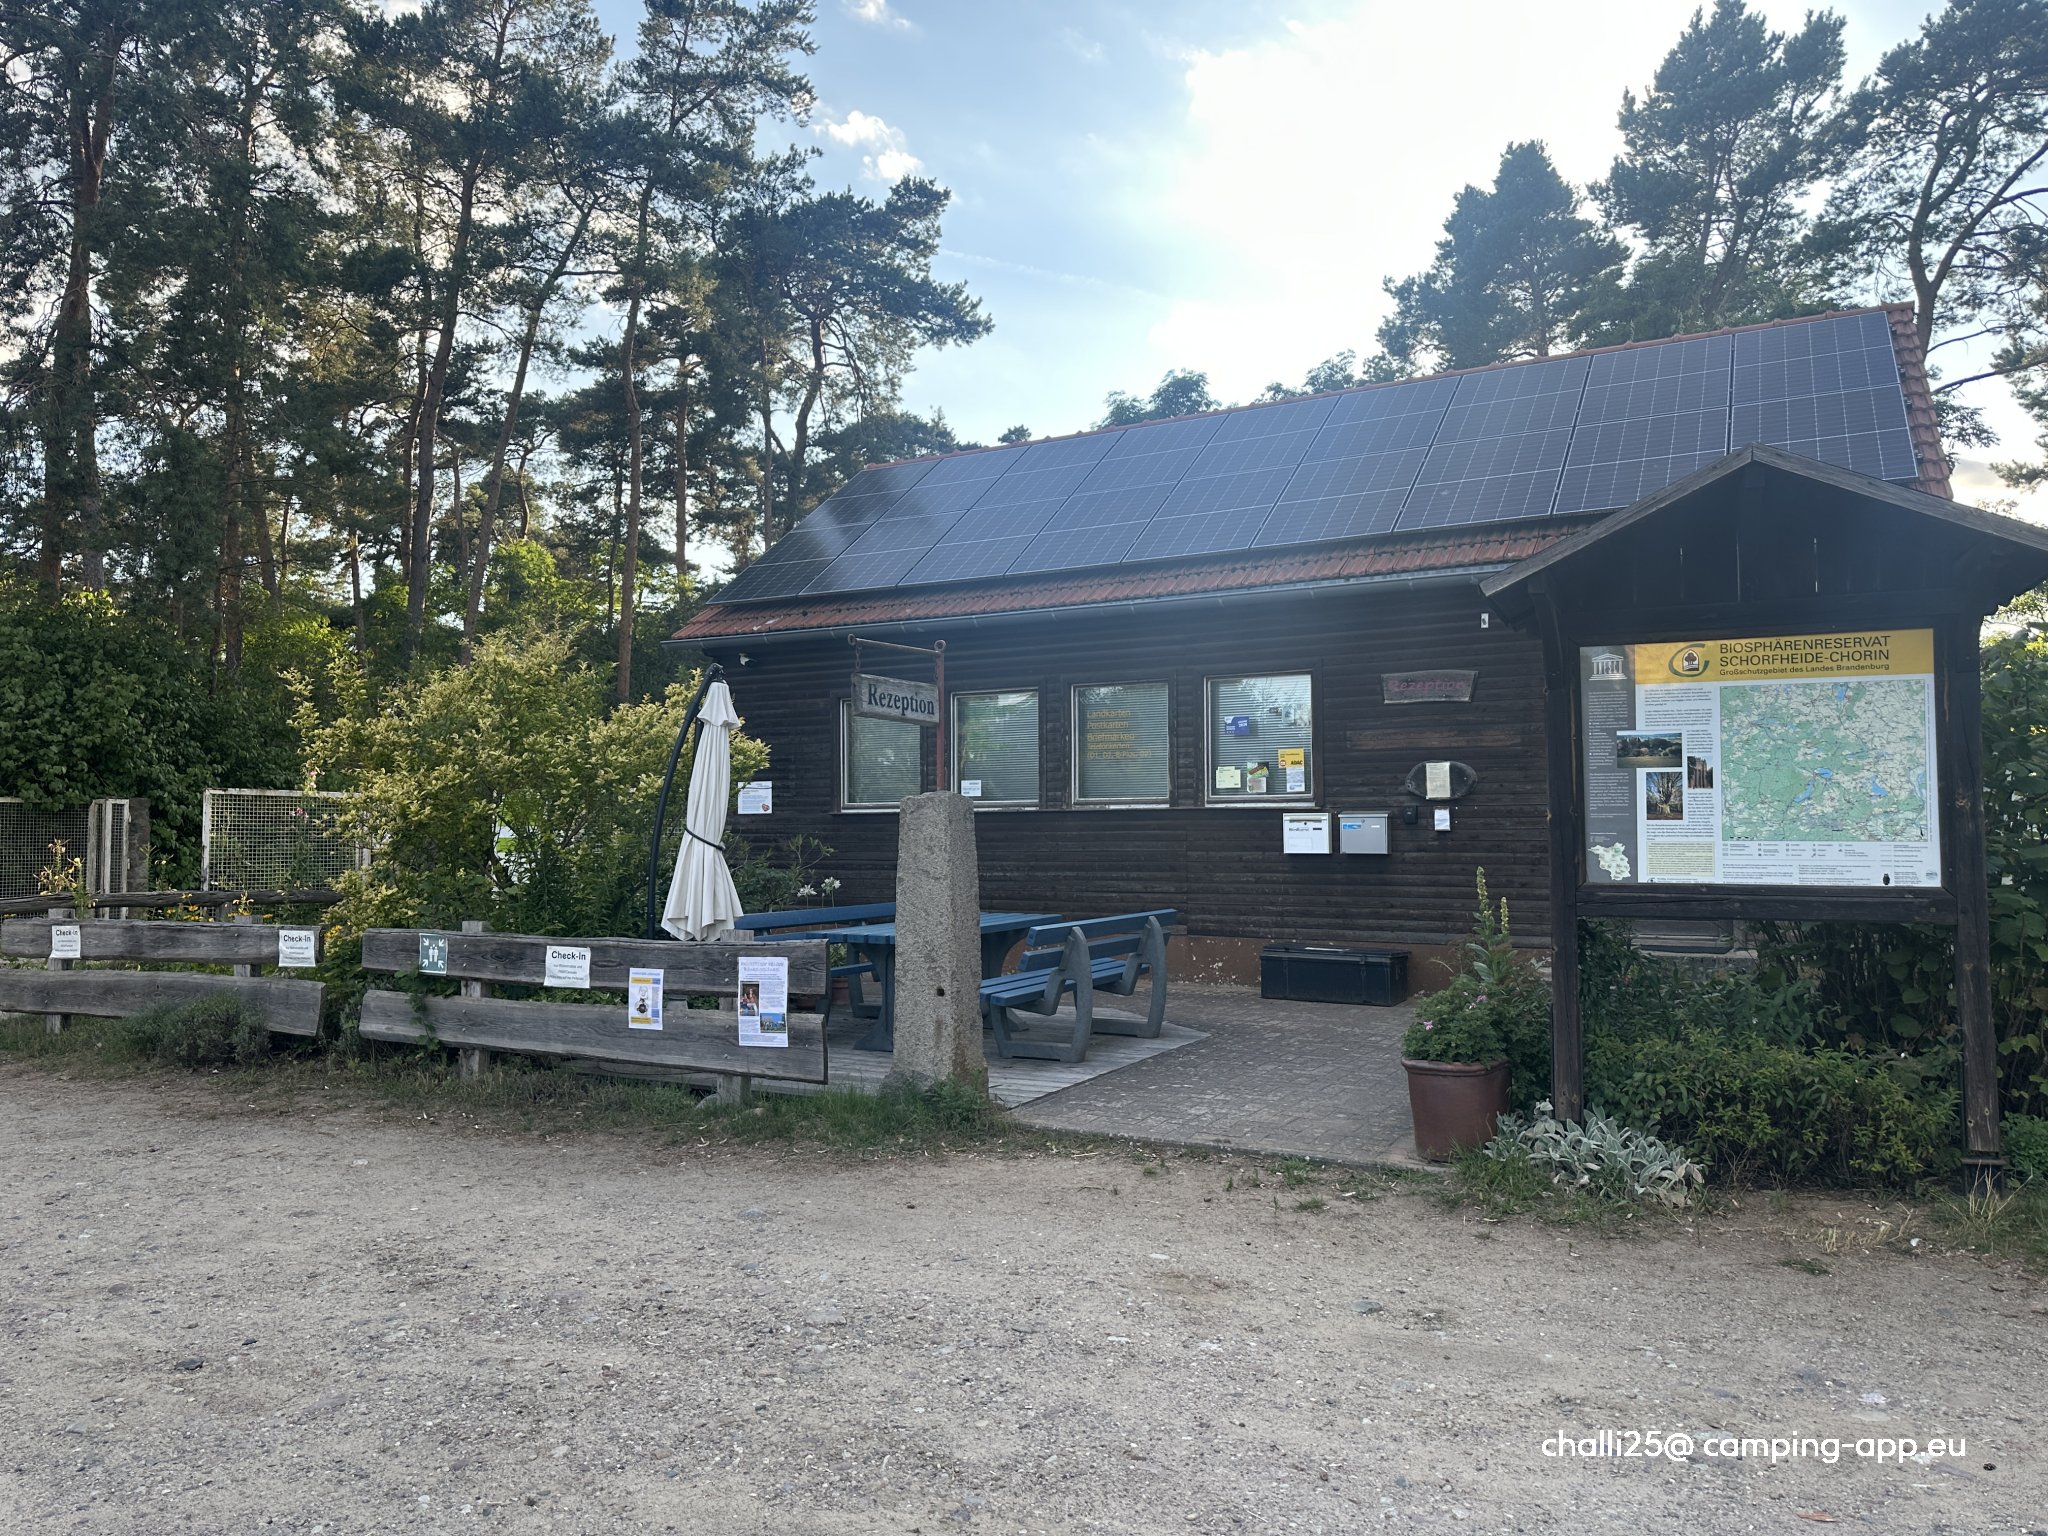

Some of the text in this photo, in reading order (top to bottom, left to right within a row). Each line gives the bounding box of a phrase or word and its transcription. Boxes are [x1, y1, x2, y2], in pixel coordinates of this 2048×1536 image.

[1719, 635, 1891, 654] BIOSPHÄRENRESERVAT
[1719, 649, 1890, 667] SCHORFHEIDE-CHORIN
[1719, 667, 1788, 676] Großschutzgebiet
[1805, 664, 1834, 672] Landes
[1836, 663, 1890, 672] Brandenburg
[868, 683, 935, 716] Rezeption
[283, 934, 311, 943] Check-In
[551, 950, 586, 960] Check-In
